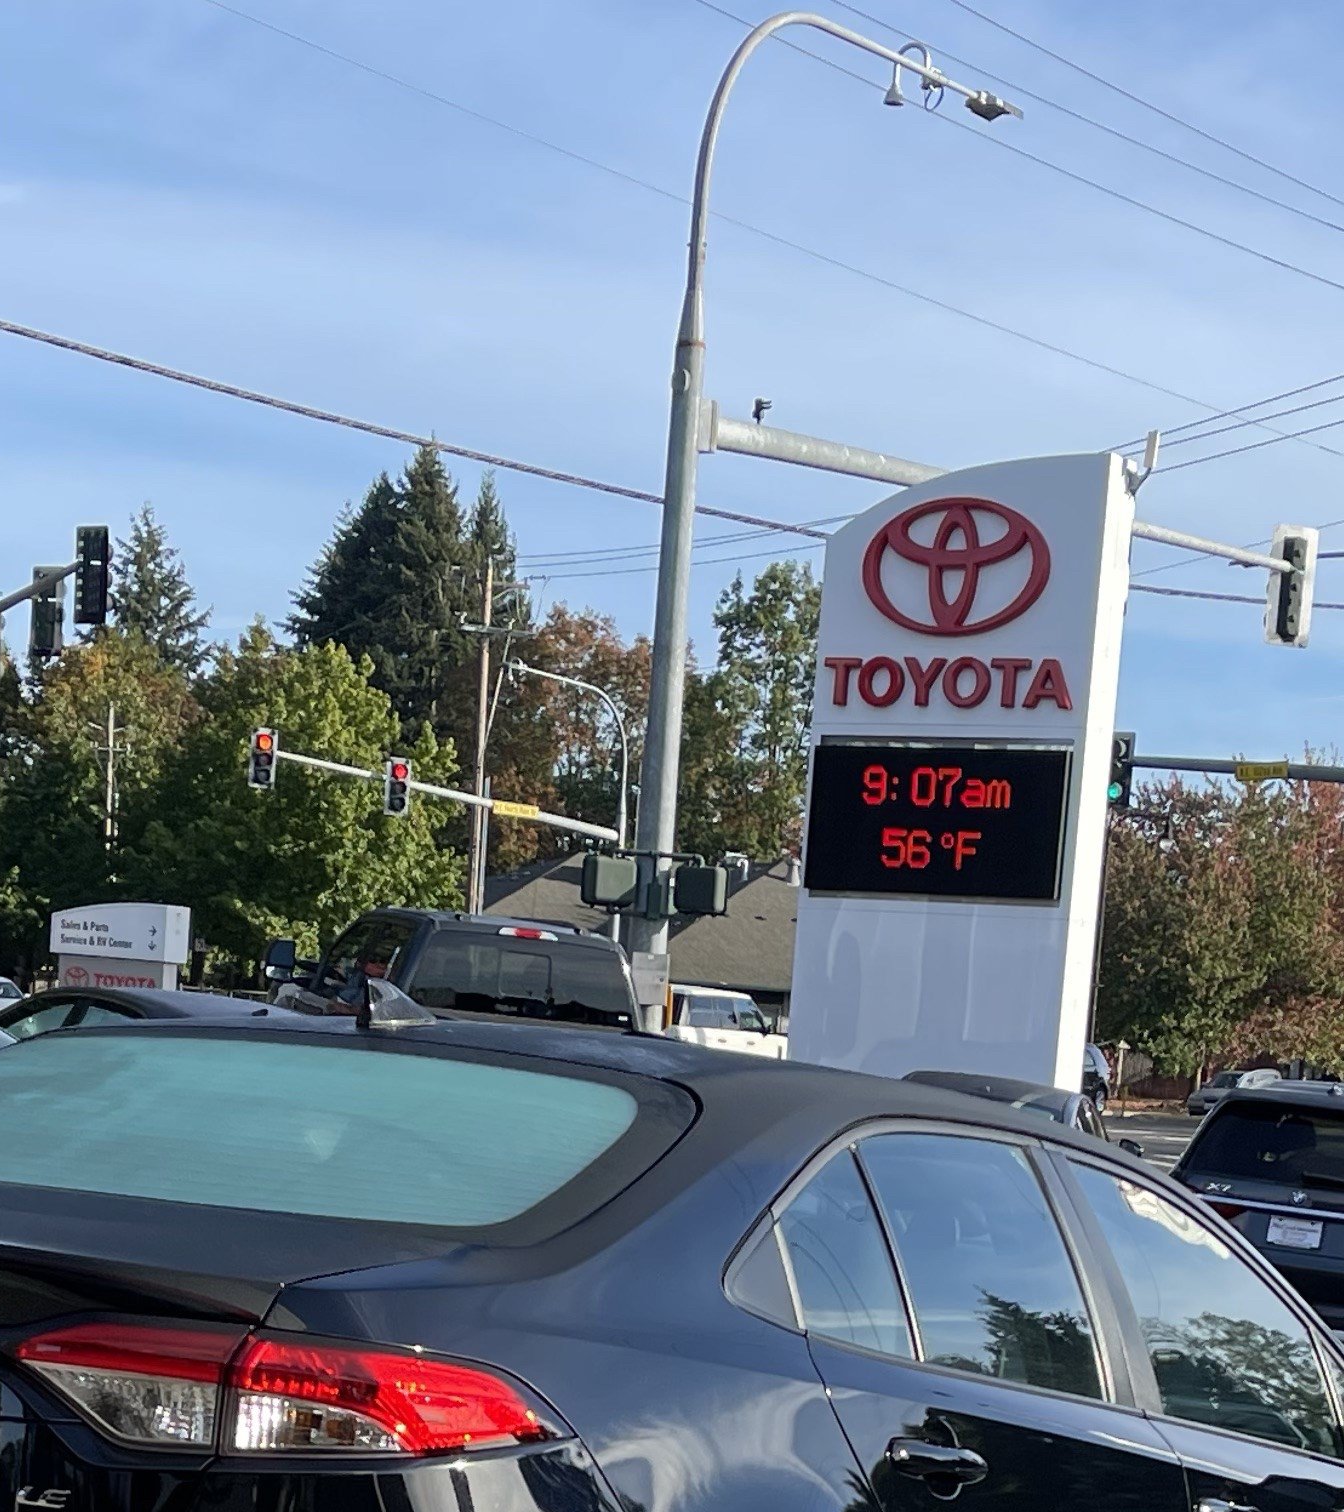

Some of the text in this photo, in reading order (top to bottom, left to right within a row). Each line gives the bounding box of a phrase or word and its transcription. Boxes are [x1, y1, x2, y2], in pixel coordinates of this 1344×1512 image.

[824, 655, 1073, 711] TOYOTA
[862, 765, 1012, 809] 9:07am
[61, 919, 109, 932] Sales & Parts
[61, 934, 87, 945] Service
[89, 936, 95, 946] &
[109, 937, 133, 949] Center
[94, 973, 155, 989] TOYOTA
